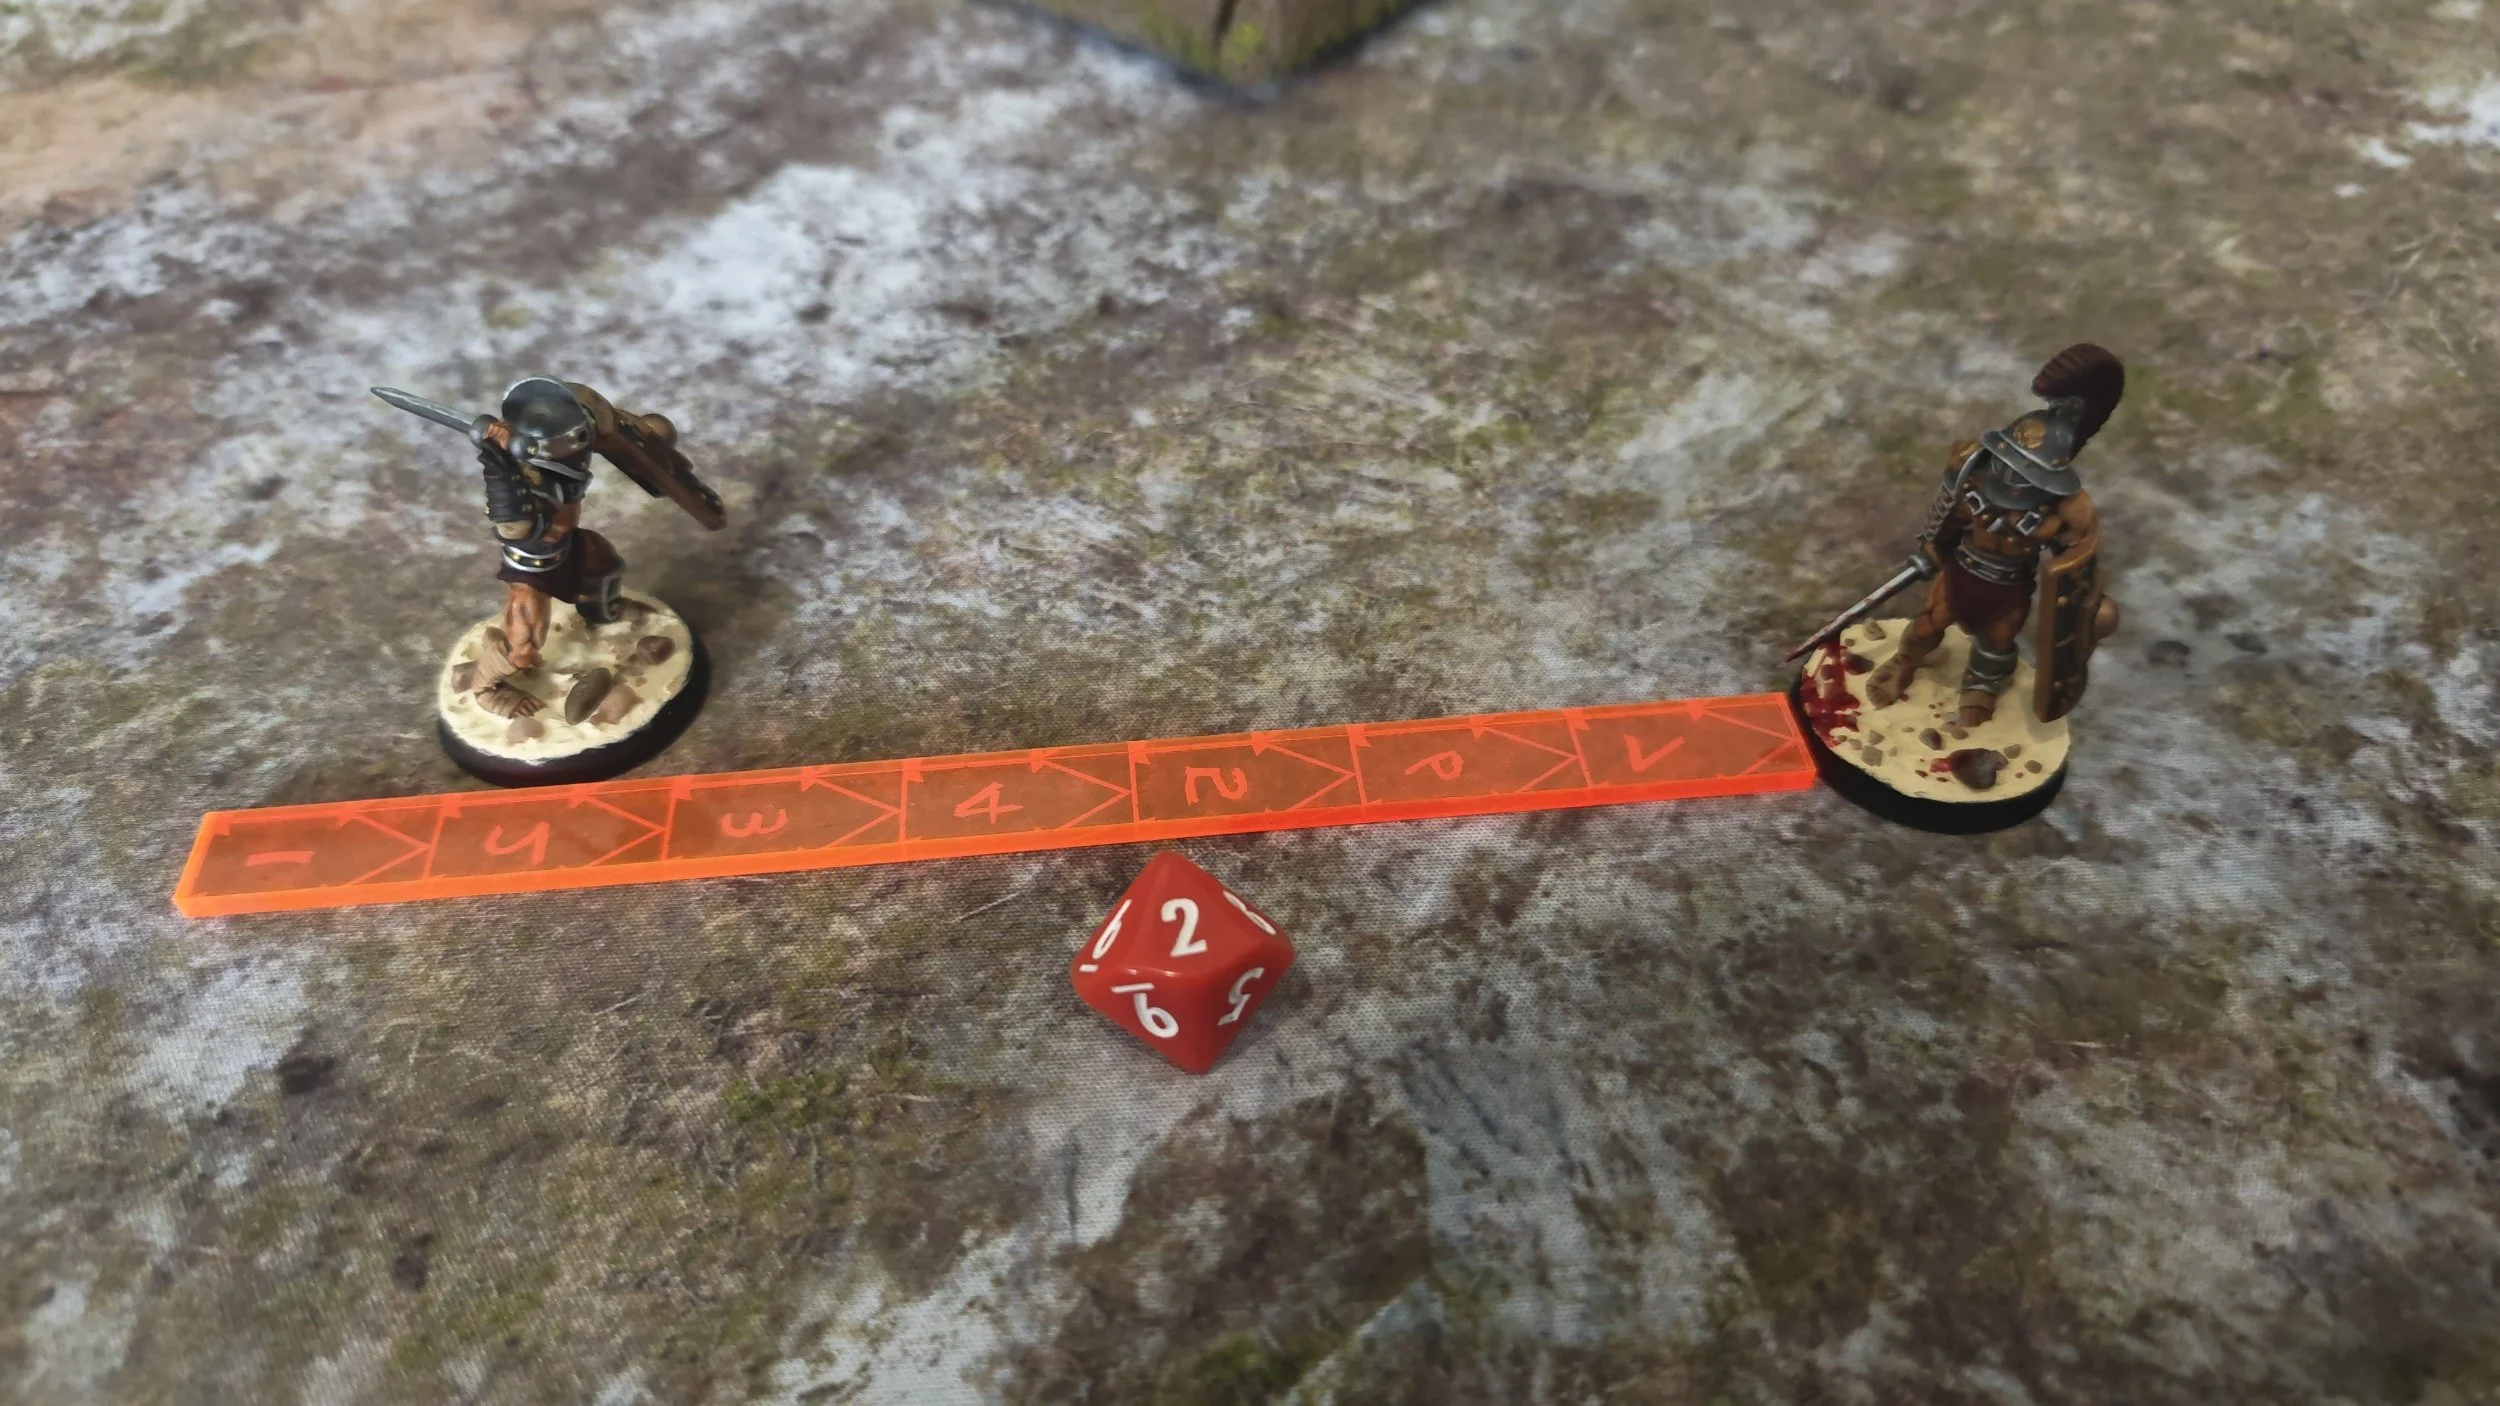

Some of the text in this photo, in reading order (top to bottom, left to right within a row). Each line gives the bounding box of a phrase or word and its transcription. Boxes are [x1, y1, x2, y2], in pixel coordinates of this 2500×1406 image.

[1079, 899, 1132, 973] 6
[1160, 897, 1208, 958] 2
[1217, 966, 1265, 1026] 5
